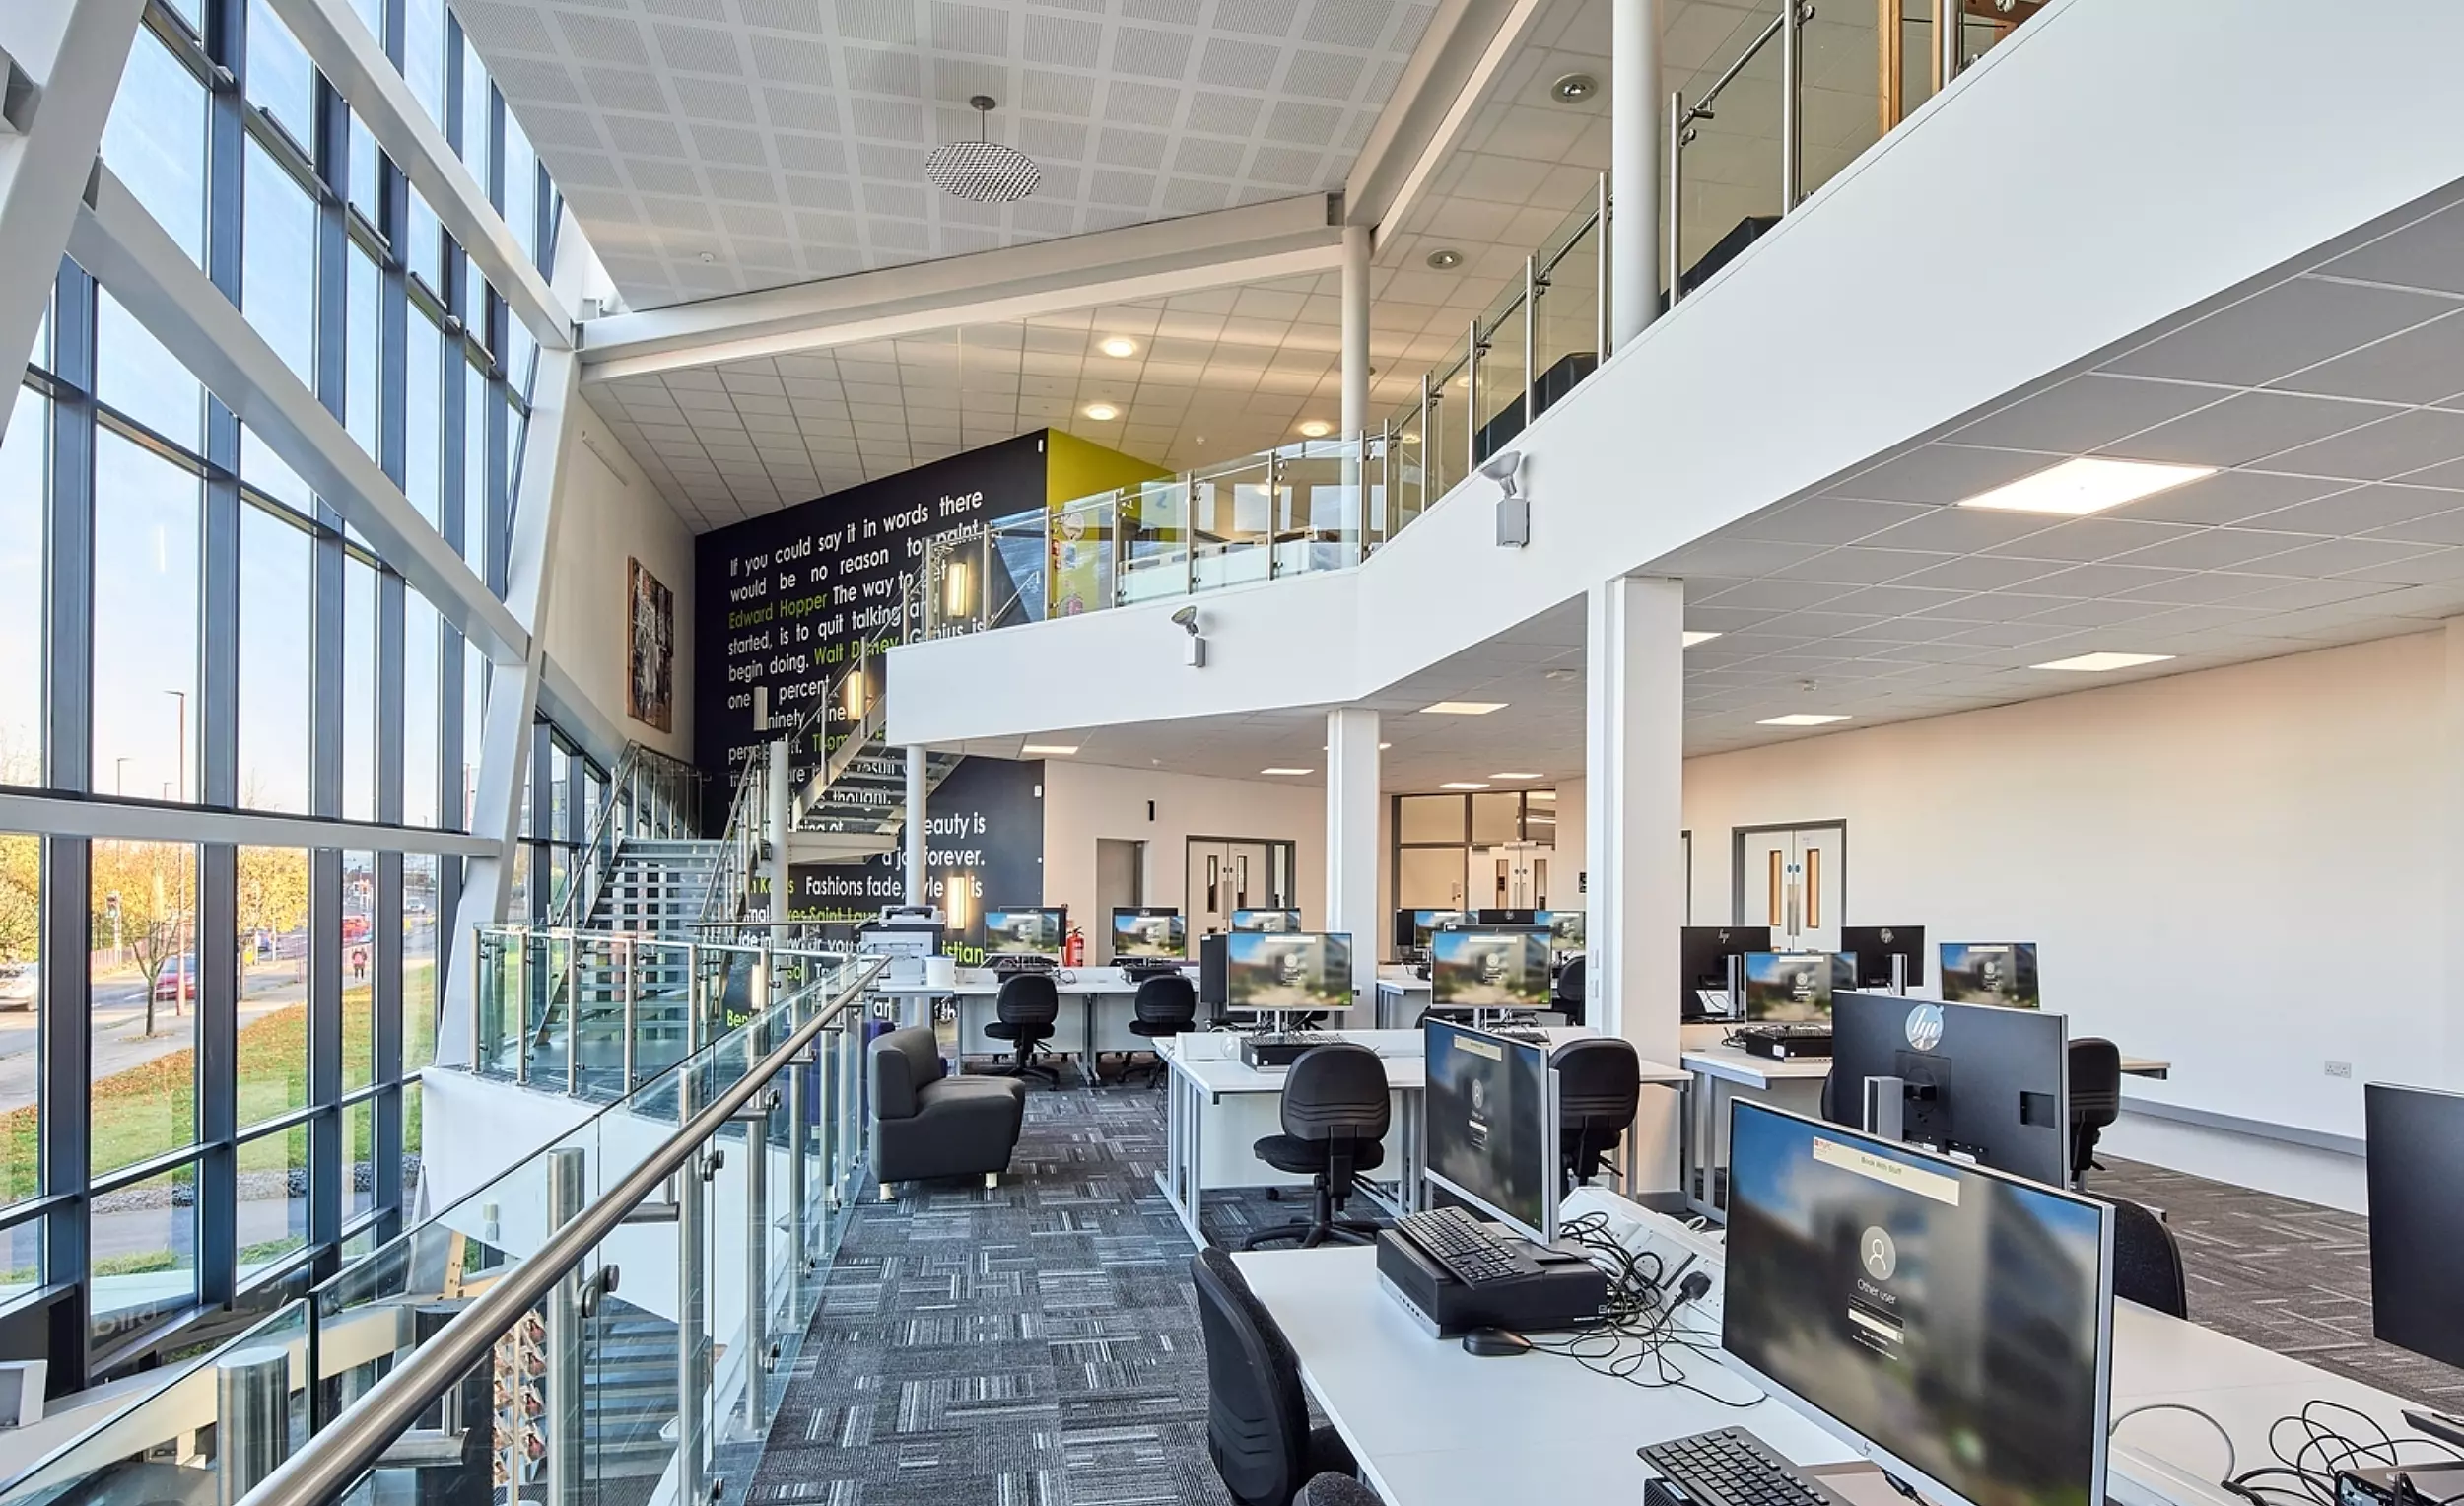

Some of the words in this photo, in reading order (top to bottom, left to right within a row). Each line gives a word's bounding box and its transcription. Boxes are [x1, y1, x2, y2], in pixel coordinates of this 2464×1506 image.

[730, 558, 738, 577] If
[745, 554, 768, 577] you
[775, 536, 811, 564] could
[818, 531, 842, 552] say
[847, 522, 856, 543] it
[863, 518, 877, 538] in
[883, 503, 929, 532] words
[939, 491, 984, 517] there
[730, 577, 767, 603] would
[780, 572, 796, 590] be
[810, 565, 828, 582] no
[840, 548, 889, 575] reason
[907, 537, 923, 558] to
[728, 602, 773, 629] Edward
[780, 593, 828, 619] Hopper
[833, 584, 856, 605] The
[862, 577, 895, 598] way
[780, 627, 789, 646] is
[796, 623, 809, 642] to
[817, 614, 844, 641] quit
[852, 603, 902, 631] talking
[728, 660, 763, 683] begin
[770, 655, 809, 674] doing.
[814, 643, 844, 666] Walt
[727, 693, 751, 710] one
[779, 674, 831, 705] percent
[924, 812, 970, 839] eauty
[973, 811, 986, 834] is
[805, 875, 863, 896] Fashions
[866, 875, 906, 899] fade,
[970, 875, 983, 898] is
[1857, 1277, 1879, 1297] Other
